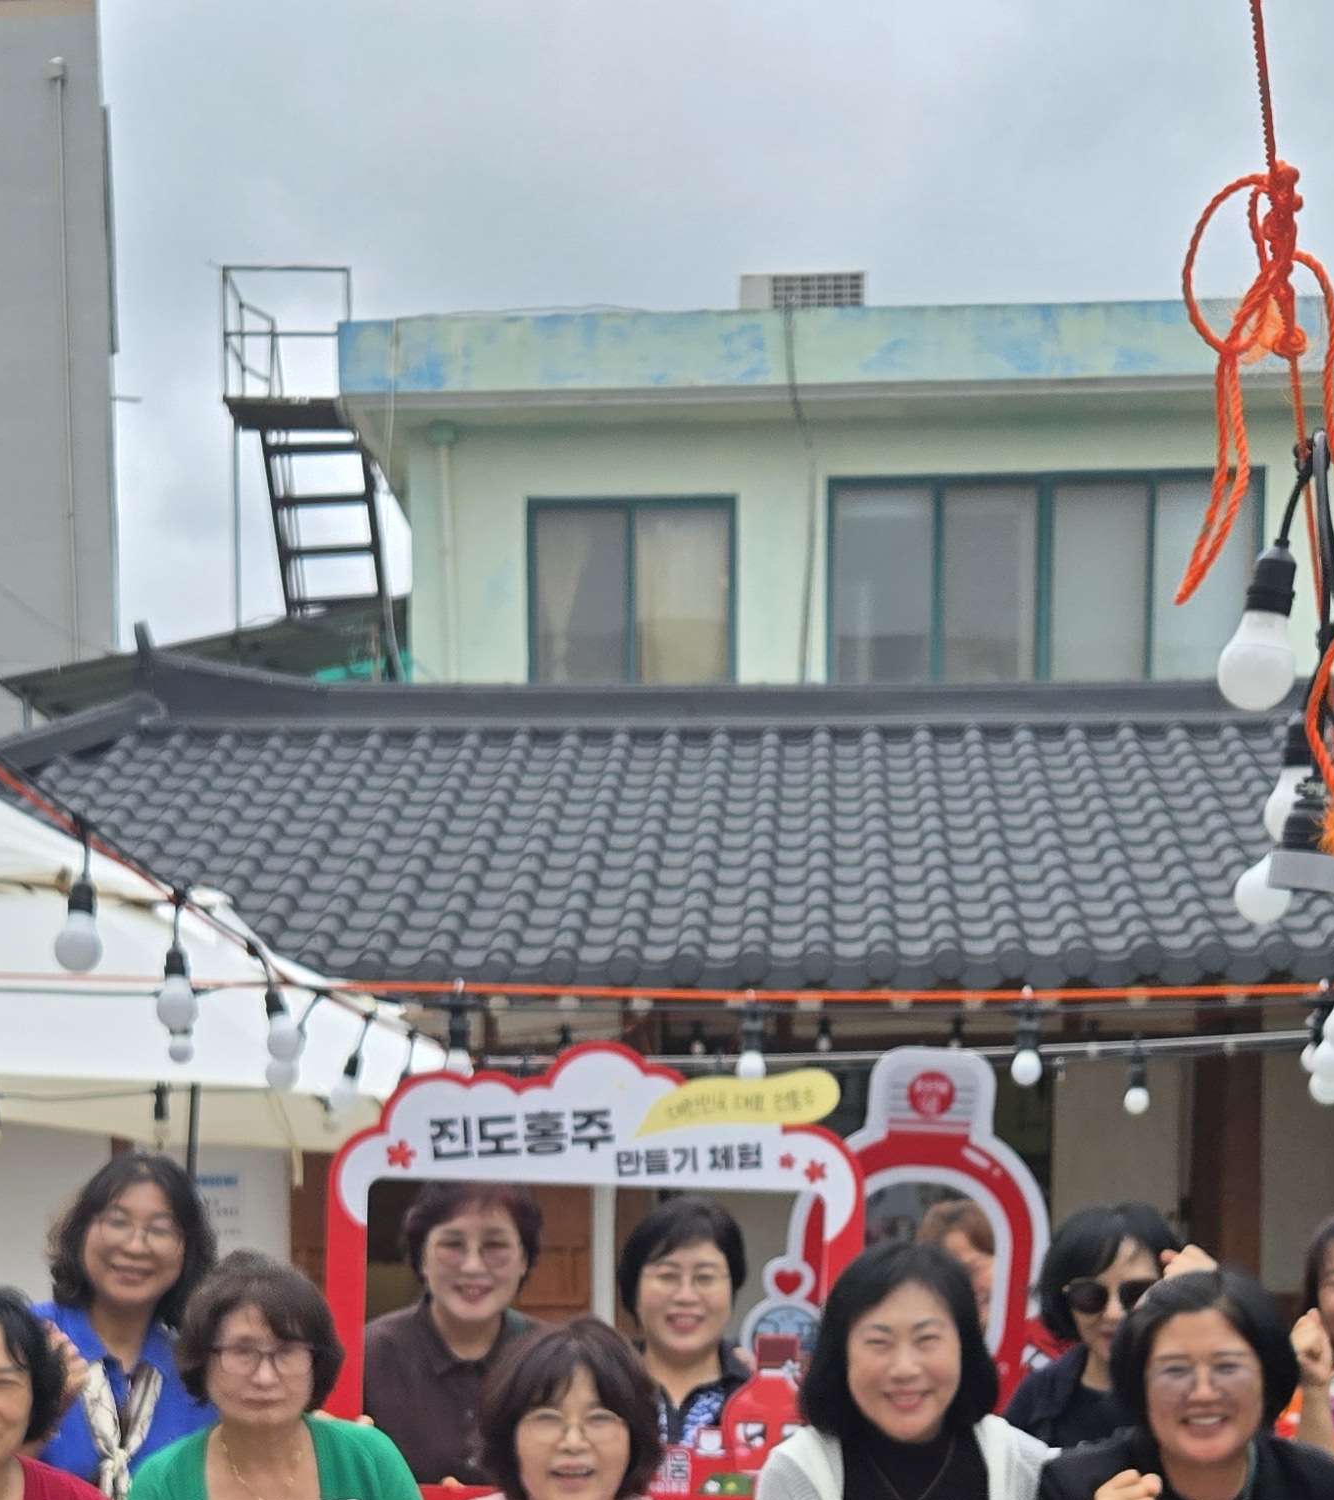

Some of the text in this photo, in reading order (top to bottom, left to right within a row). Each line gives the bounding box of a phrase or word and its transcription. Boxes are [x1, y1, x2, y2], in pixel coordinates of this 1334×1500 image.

[428, 1109, 615, 1161] 진도홍주
[617, 1142, 763, 1176] 만들기 체험
